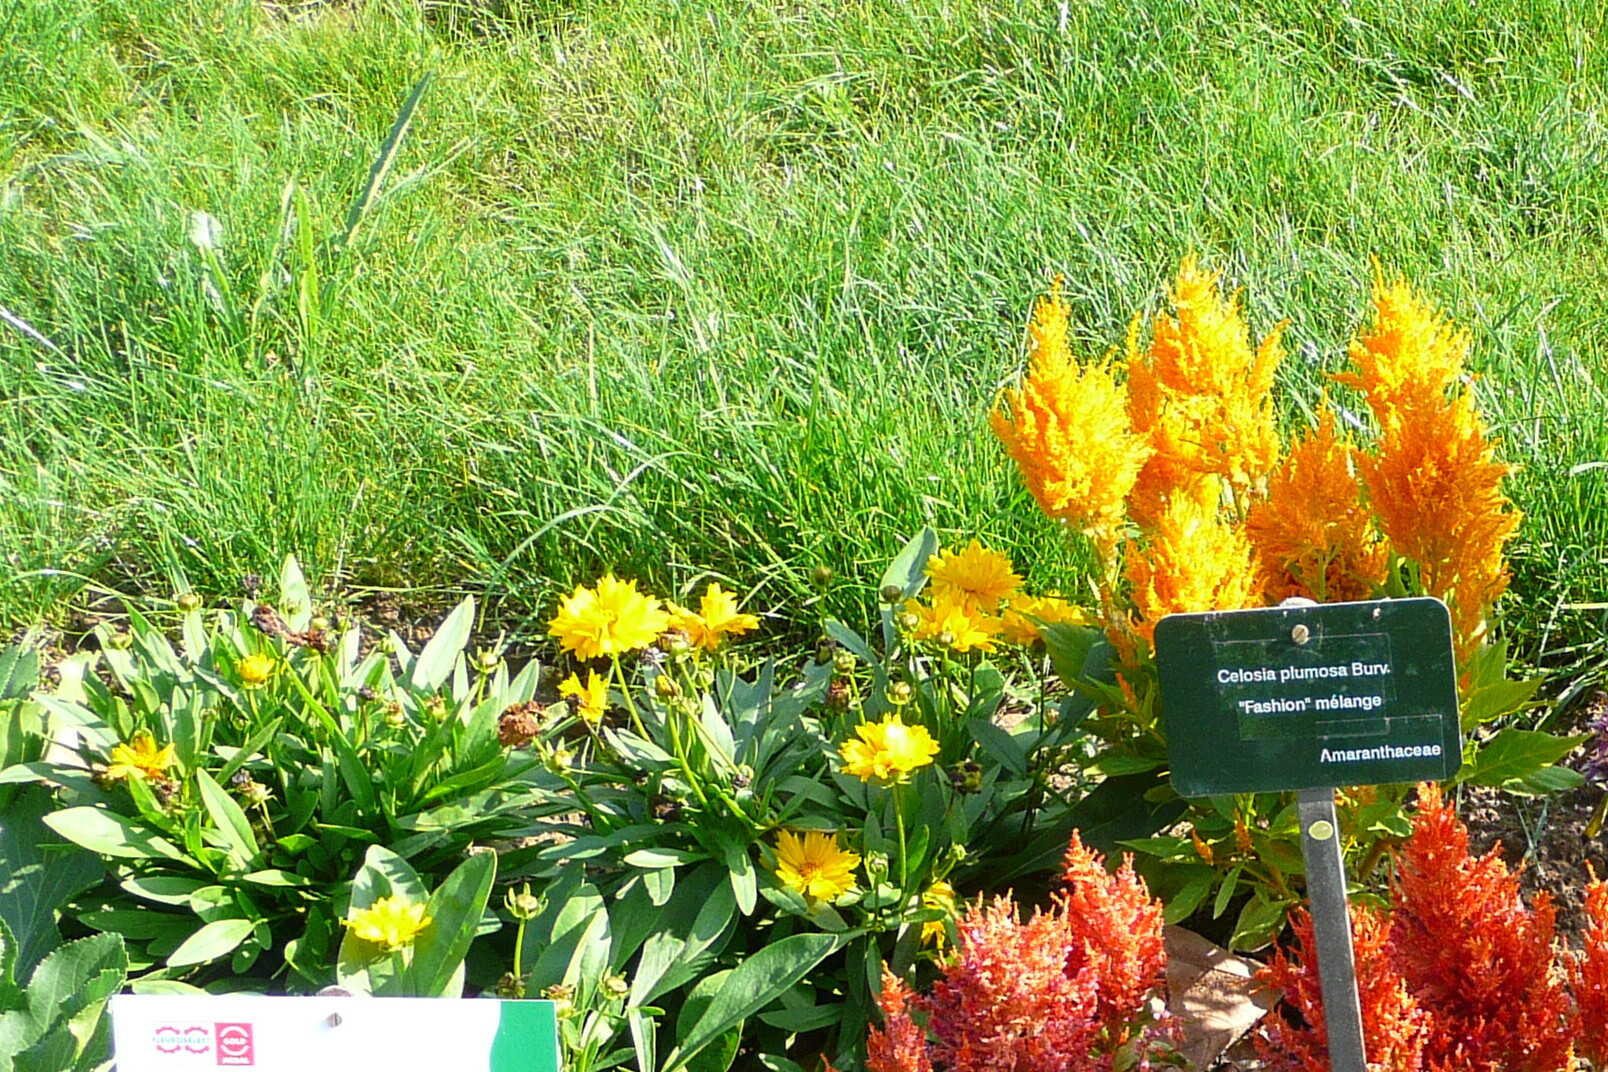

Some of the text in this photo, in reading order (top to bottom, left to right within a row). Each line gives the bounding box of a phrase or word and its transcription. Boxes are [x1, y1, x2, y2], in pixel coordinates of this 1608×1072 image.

[1217, 662, 1391, 684] Celosia plumosa Burv.
[1238, 695, 1382, 714] "Fashion" mélange
[1320, 744, 1442, 763] Amaranthaceae
